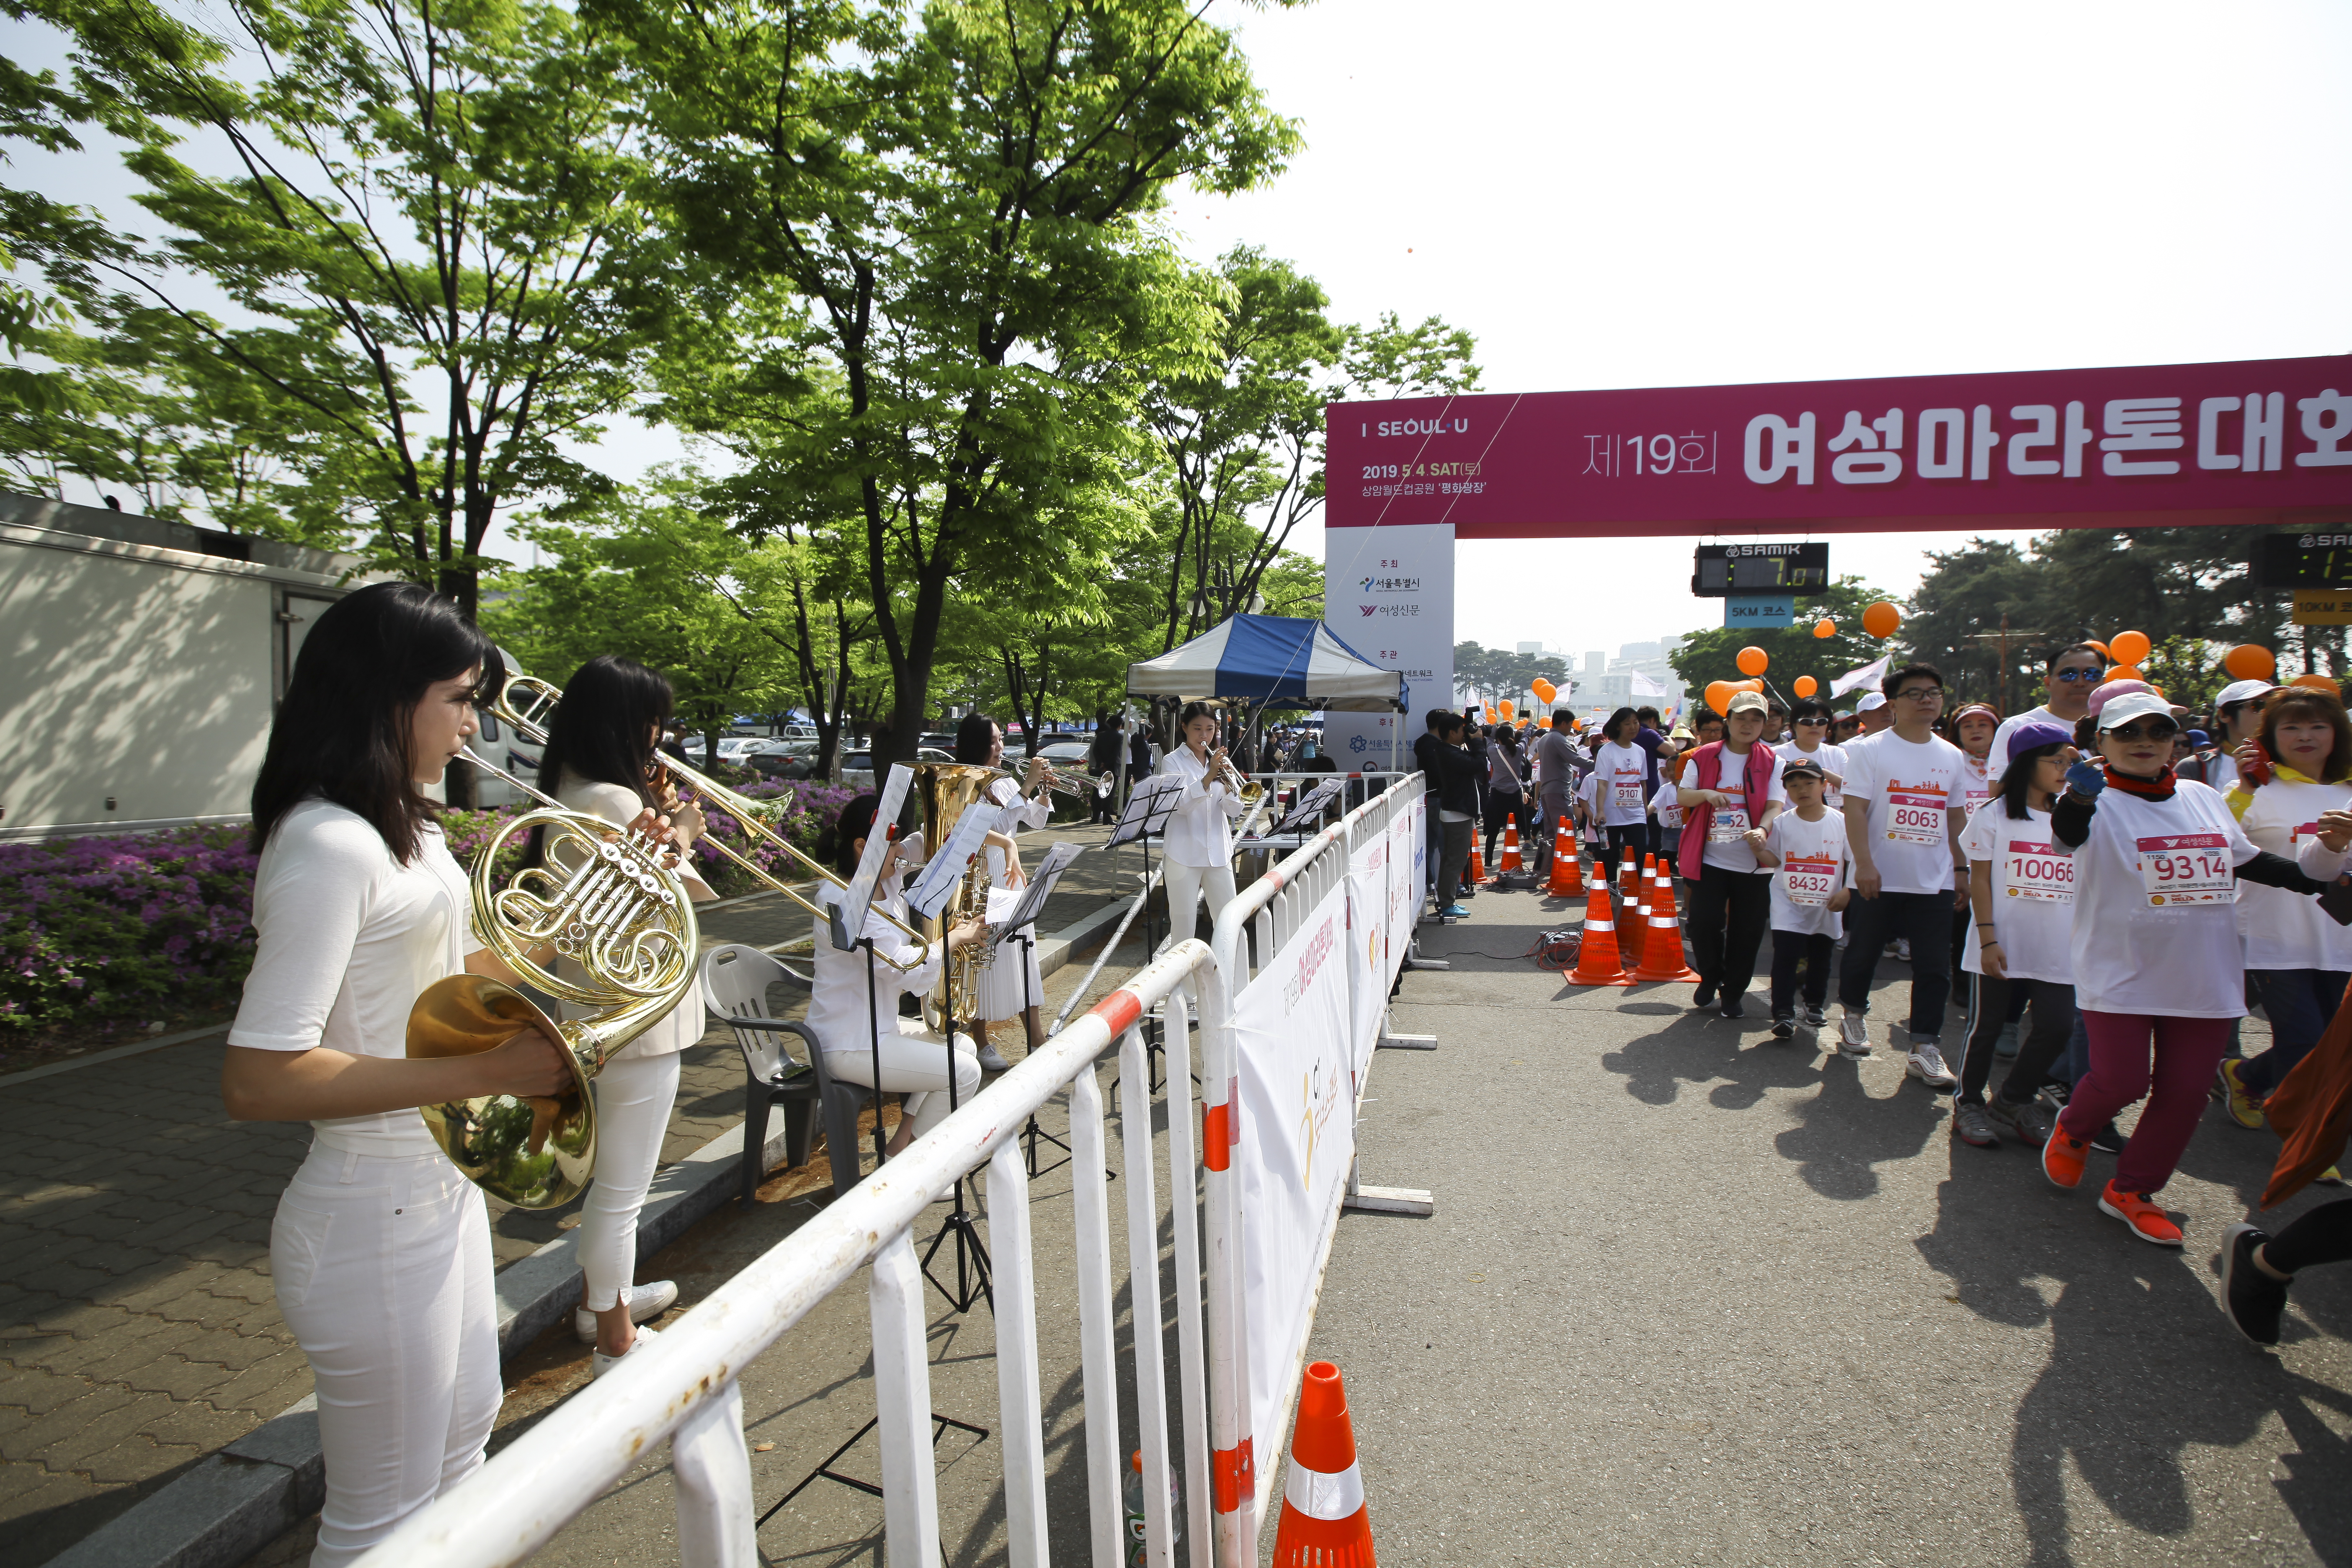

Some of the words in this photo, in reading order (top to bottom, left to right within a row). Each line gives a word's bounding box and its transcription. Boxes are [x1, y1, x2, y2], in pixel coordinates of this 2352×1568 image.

[1582, 430, 1717, 477] 제19회
[1744, 388, 2352, 485] 여성마라톤대회
[1362, 483, 1434, 496] 상암월드컵공원
[1741, 544, 1800, 555] SAMIK
[1376, 578, 1420, 588] 서울특별시
[1380, 604, 1420, 616] 여성신문
[1732, 607, 1758, 617] 5KM
[1762, 606, 1786, 616] 코스
[2297, 602, 2336, 612] 10KM
[1619, 789, 1638, 798] 9107
[1896, 809, 1938, 828] 8063
[2181, 837, 2214, 846] 여성신문
[2012, 859, 2073, 882] 10066
[2155, 856, 2226, 880] 9314
[1789, 876, 1828, 892] 8432
[1283, 969, 1300, 1019] 제19회
[1299, 913, 1333, 996] 여성마라톤대회
